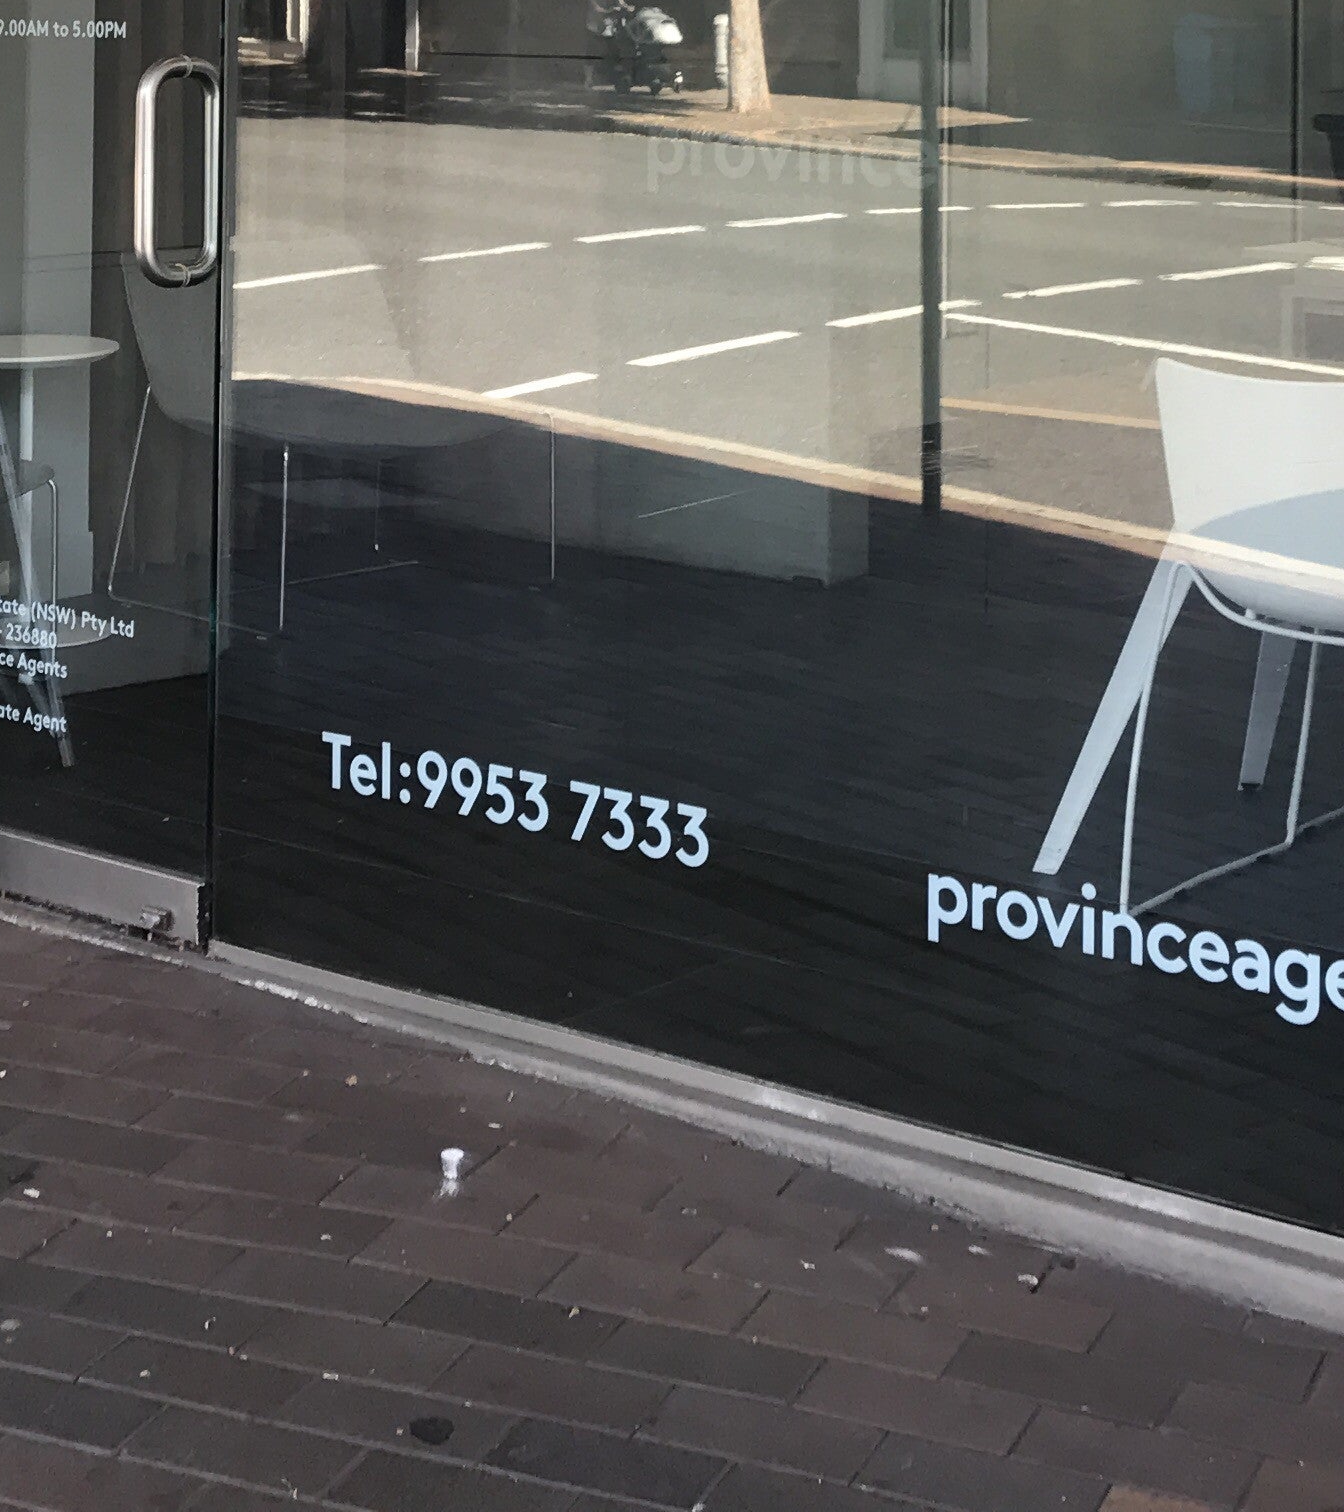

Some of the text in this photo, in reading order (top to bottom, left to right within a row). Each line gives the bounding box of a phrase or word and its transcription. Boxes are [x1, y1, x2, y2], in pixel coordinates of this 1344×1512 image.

[53, 22, 69, 38] to
[72, 20, 127, 39] 5.00PM
[31, 600, 76, 630] (NSW)
[81, 611, 108, 637] Pty
[110, 616, 135, 638] Ltd
[17, 652, 68, 679] Agents
[23, 707, 67, 733] Agent
[568, 780, 711, 868] 7333
